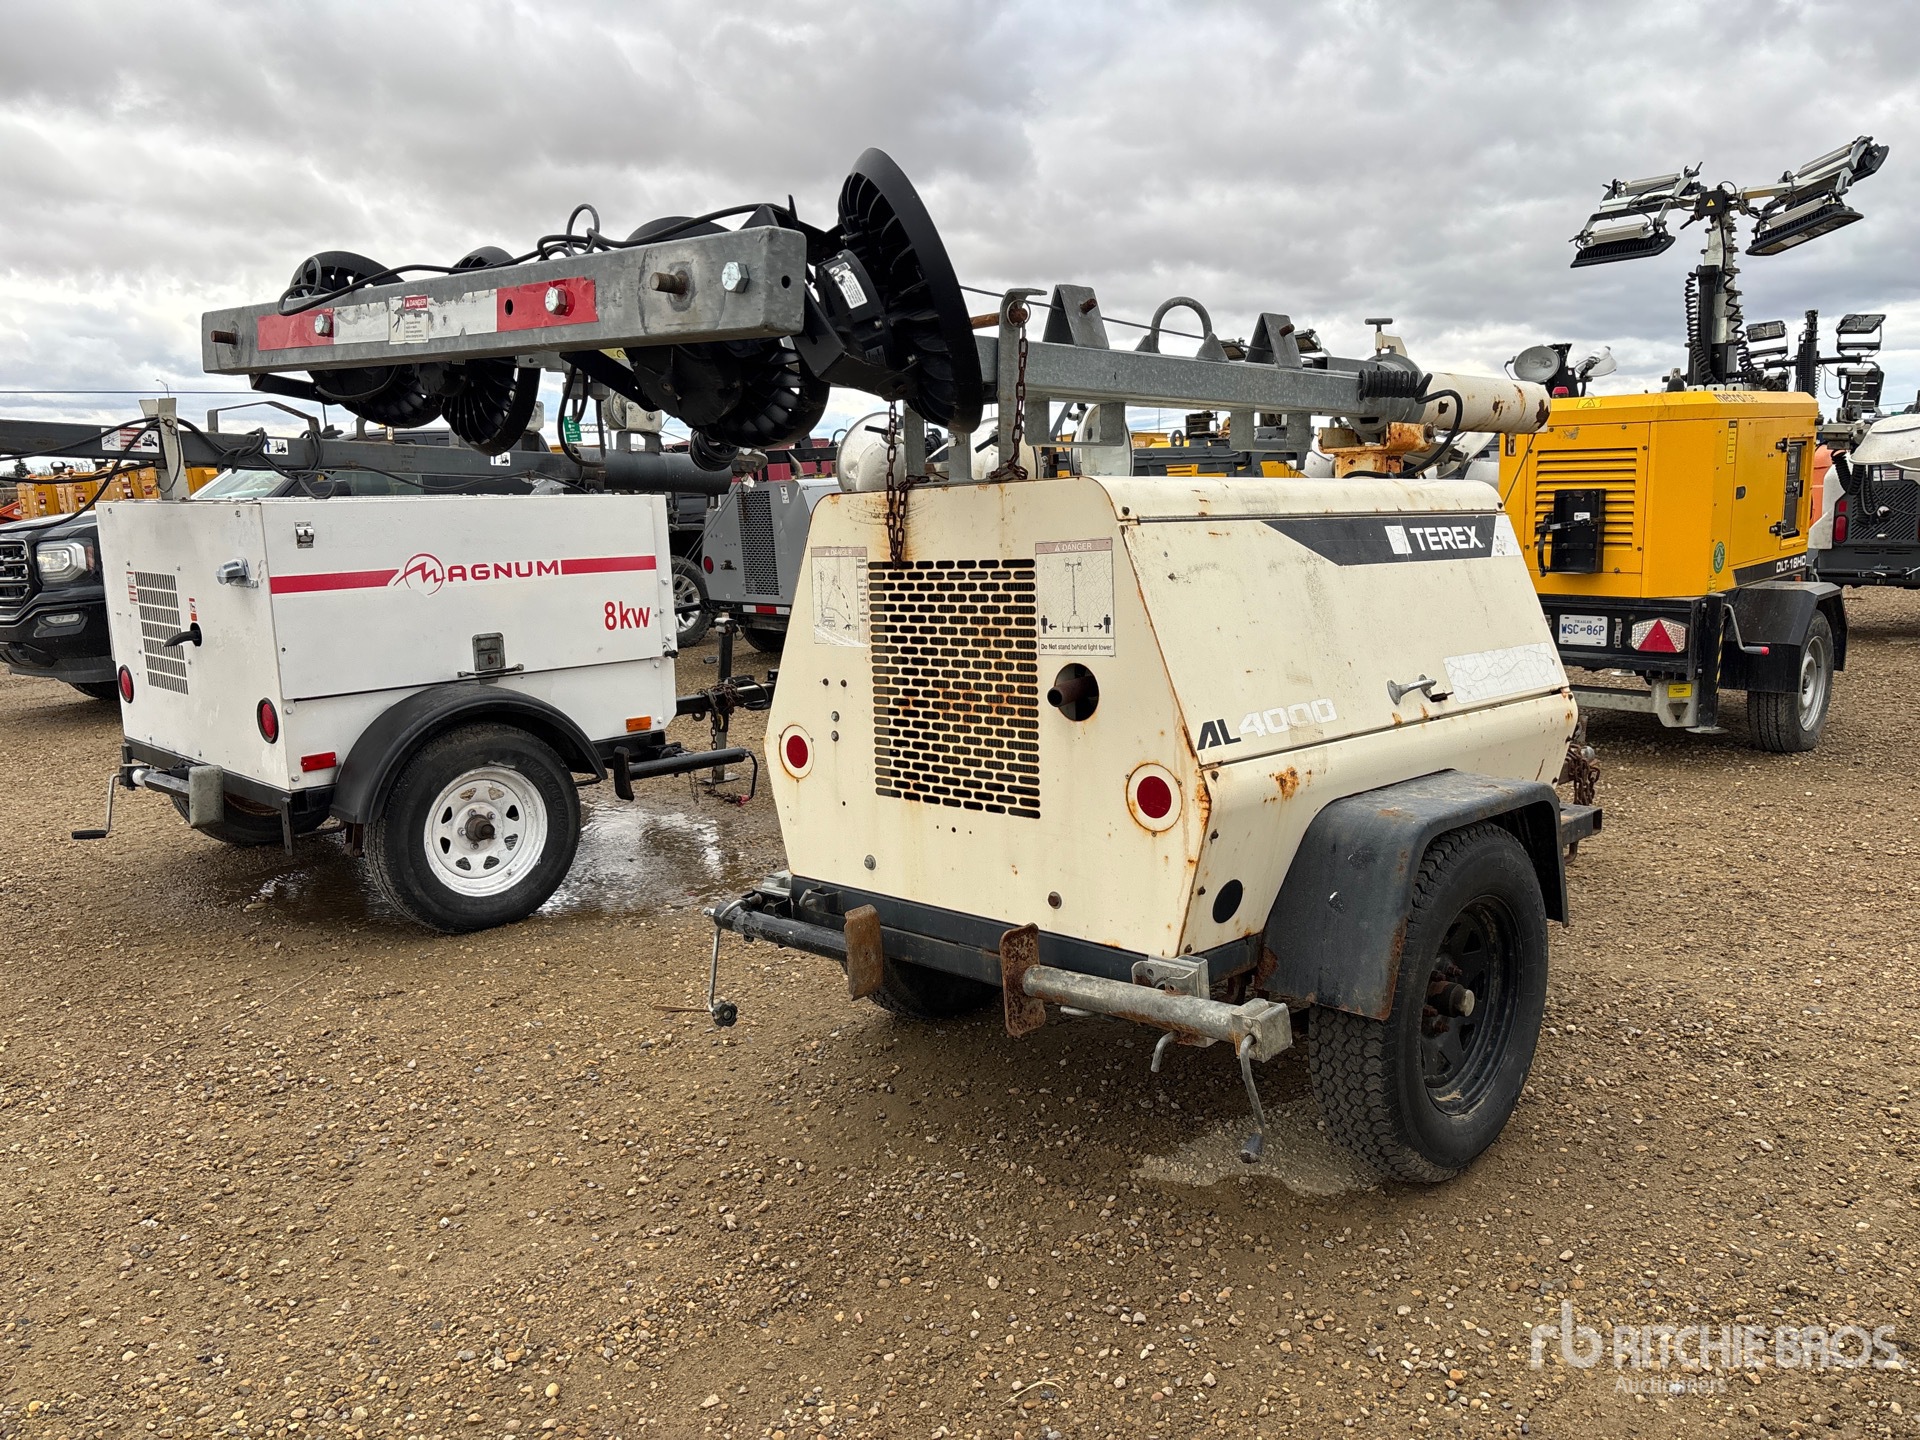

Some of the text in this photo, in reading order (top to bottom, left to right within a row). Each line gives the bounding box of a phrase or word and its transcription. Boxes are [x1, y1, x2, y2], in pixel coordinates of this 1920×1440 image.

[409, 299, 427, 308] DANGER
[1409, 525, 1483, 551] TEREX
[1062, 543, 1092, 551] DANGER
[1776, 555, 1806, 573] DLT-18HD
[393, 553, 559, 596] MAGNUM
[1088, 643, 1098, 651] light
